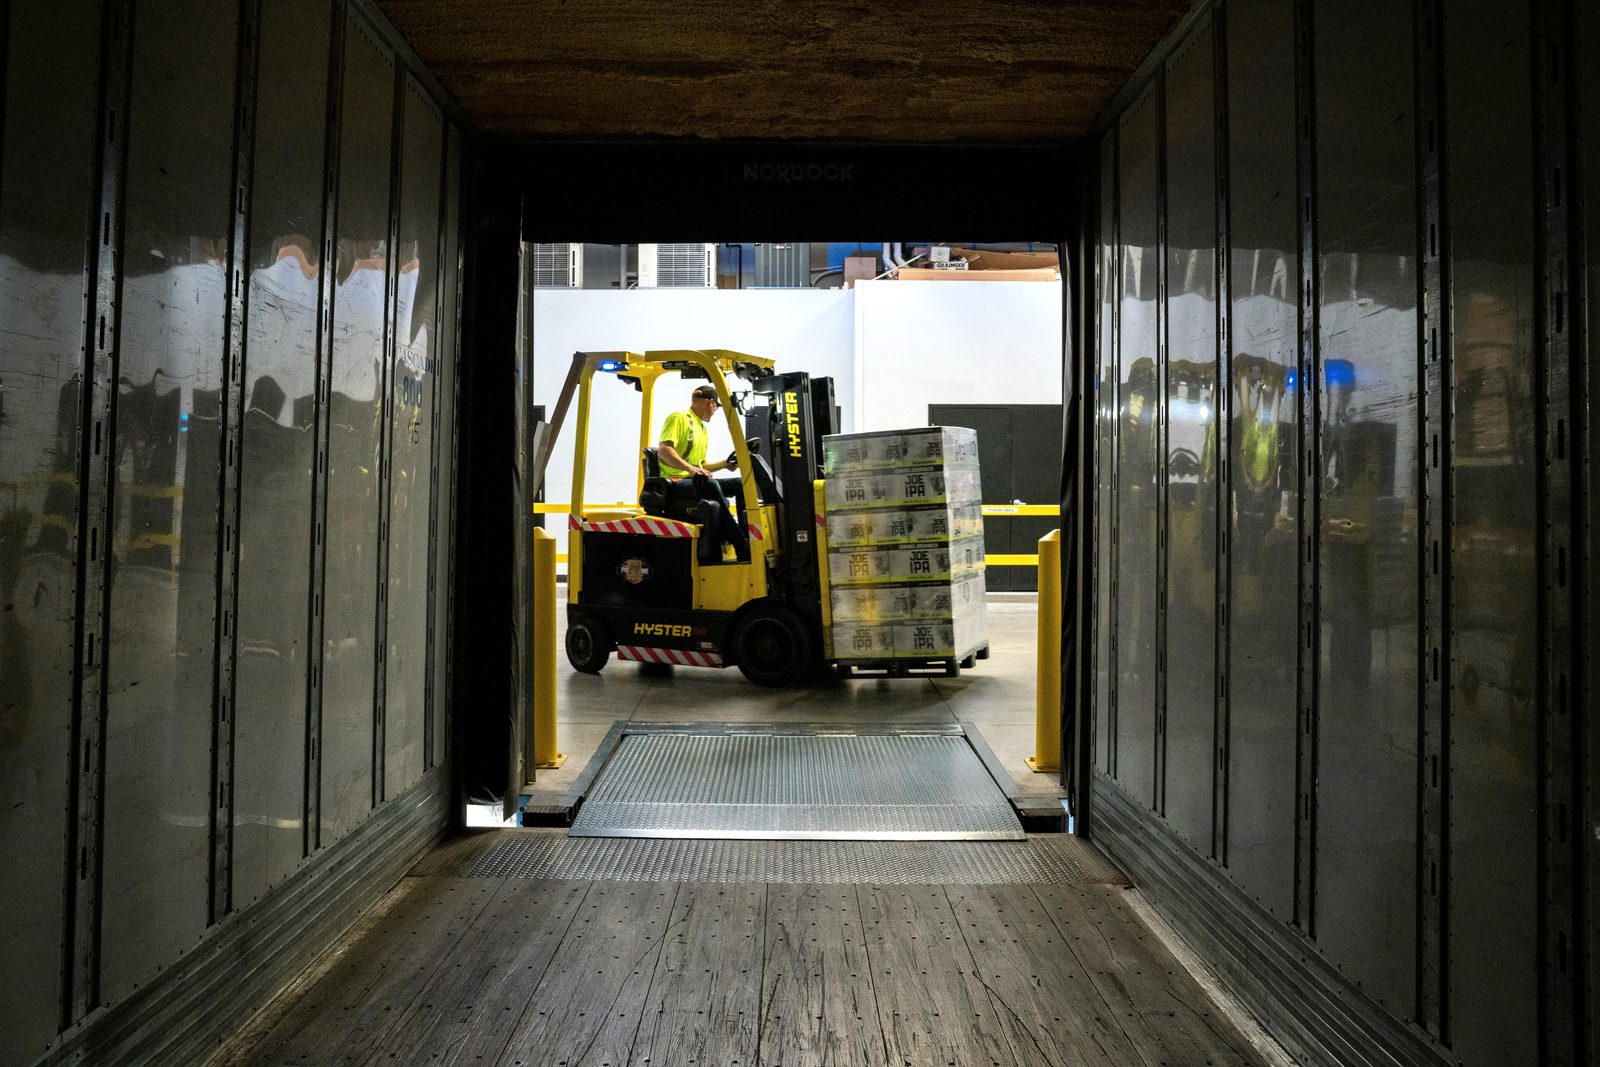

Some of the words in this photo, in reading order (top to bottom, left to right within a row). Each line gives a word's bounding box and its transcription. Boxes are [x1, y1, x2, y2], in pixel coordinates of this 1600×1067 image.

[743, 163, 855, 183] NORDOCK
[403, 376, 422, 408] 800
[785, 391, 802, 458] HYSTER
[845, 479, 864, 489] JOE
[904, 475, 924, 485] JOE
[846, 489, 865, 501] IPA
[905, 485, 925, 497] IPA
[892, 527, 906, 537] IPA
[850, 554, 868, 564] JOE
[910, 551, 929, 561] JOE
[850, 564, 869, 577] IPA
[910, 561, 930, 573] IPA
[633, 623, 692, 637] HYSTER
[853, 628, 871, 639] JOE
[914, 627, 934, 637] JOE
[853, 639, 872, 650] IPA
[914, 637, 935, 649] IPA
